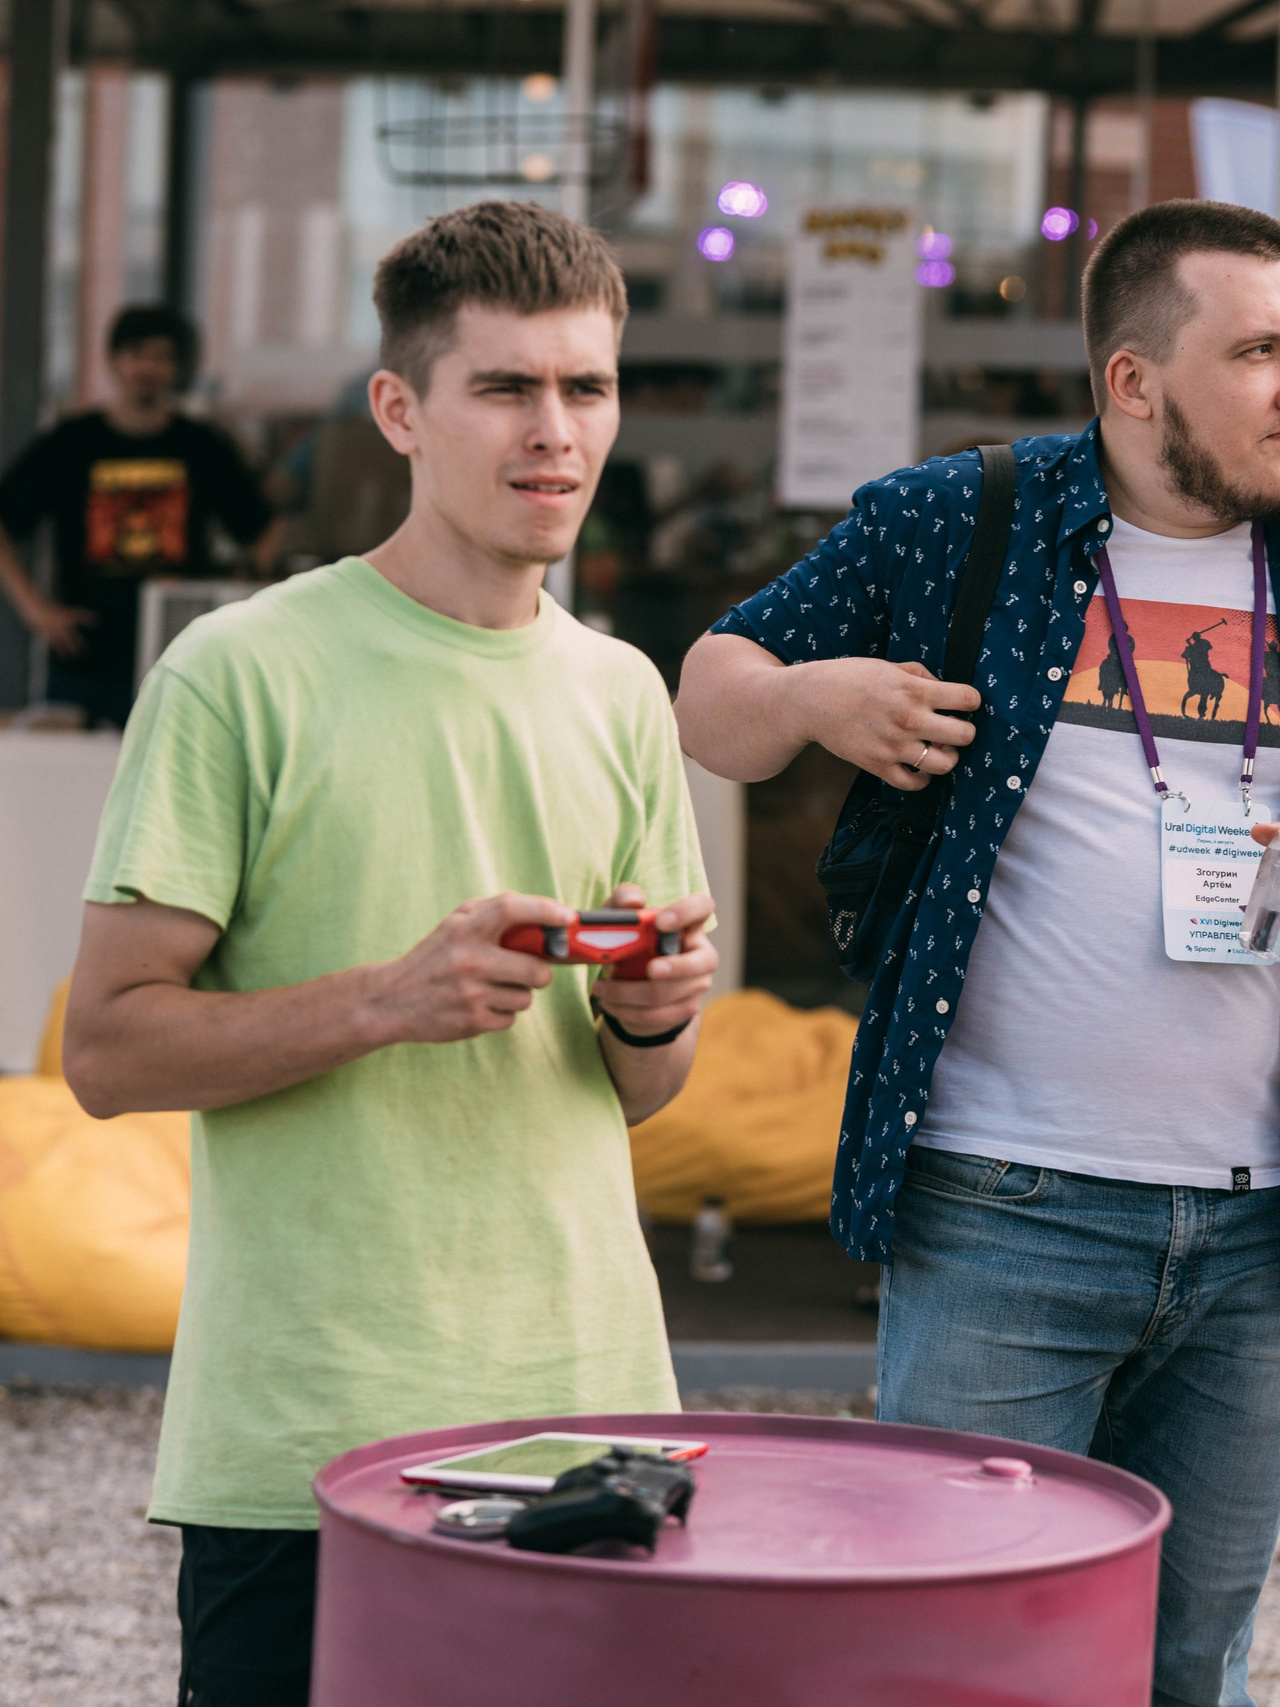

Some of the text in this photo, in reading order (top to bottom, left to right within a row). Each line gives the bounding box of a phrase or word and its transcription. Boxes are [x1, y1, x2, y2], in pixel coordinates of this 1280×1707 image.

[1165, 822, 1251, 837] Ural Digital Weeke
[1169, 844, 1264, 859] #udweek #digiweek
[1196, 867, 1238, 879] Згогурин
[1202, 880, 1232, 890] Артём
[1195, 894, 1240, 904] EdgeCenter
[1189, 930, 1240, 941] УПРАВЛЕН
